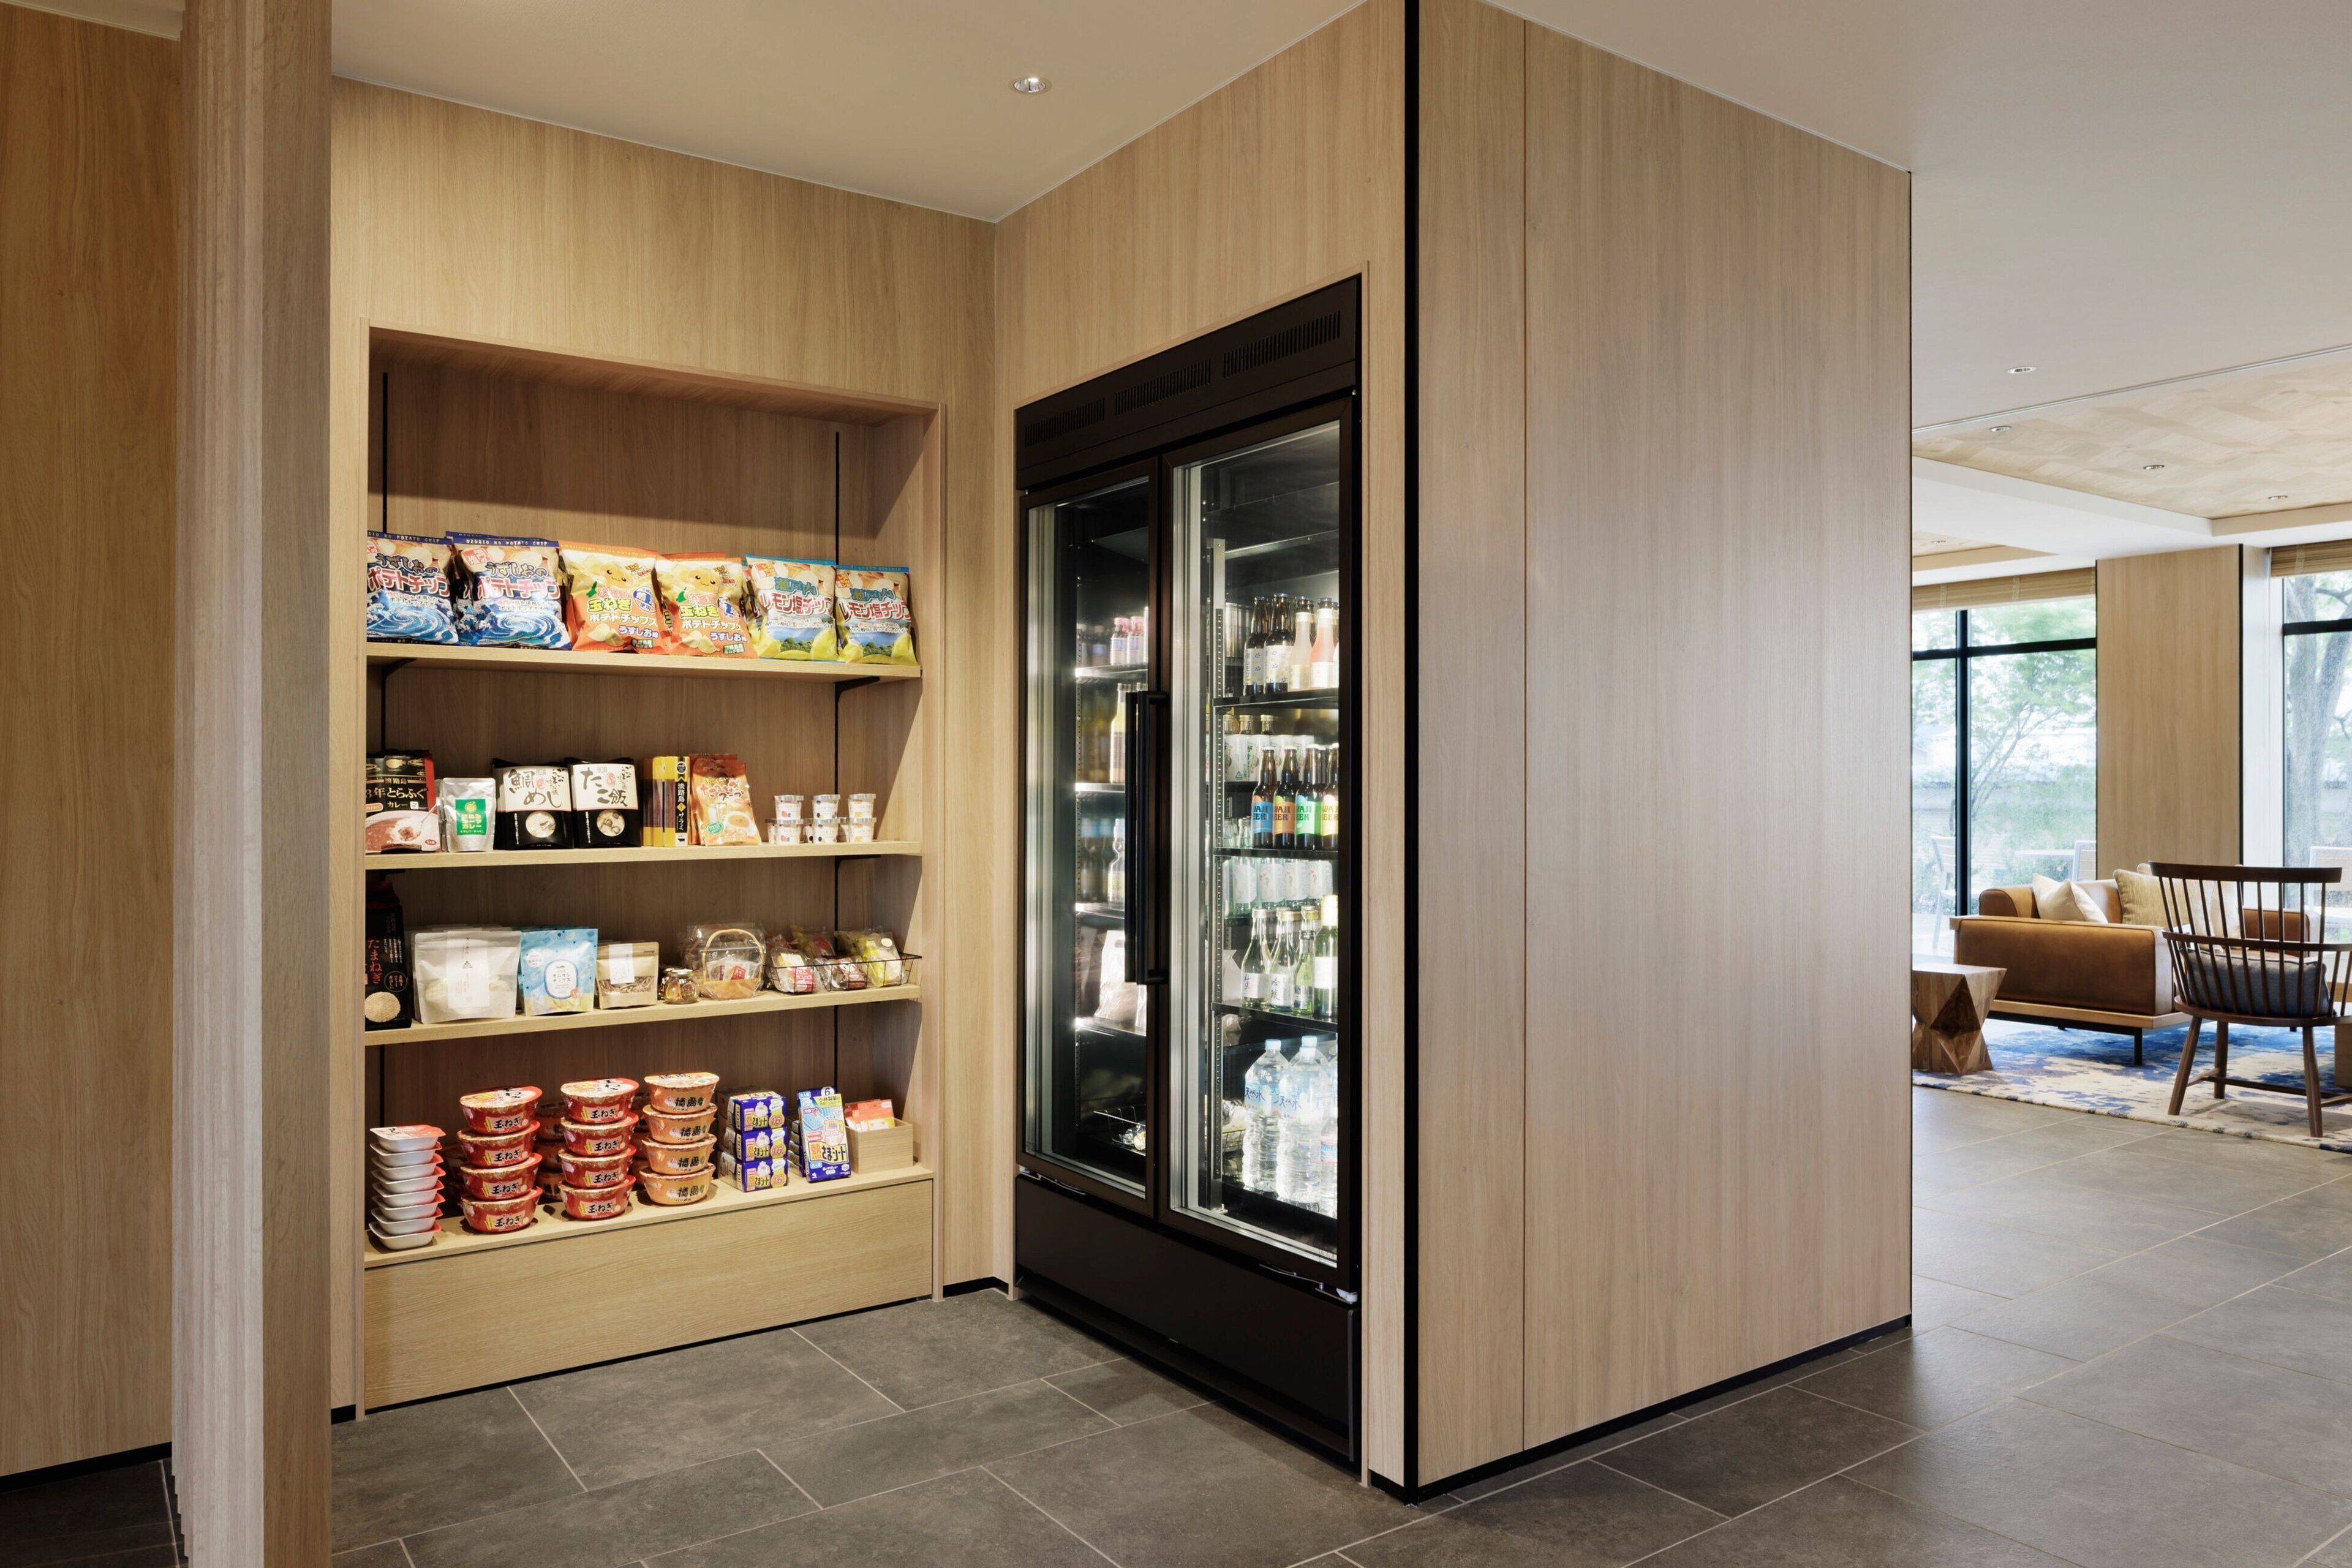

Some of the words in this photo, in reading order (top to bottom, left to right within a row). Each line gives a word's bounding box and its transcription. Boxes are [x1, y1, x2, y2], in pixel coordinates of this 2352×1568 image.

[375, 552, 439, 575] うずしおの
[484, 561, 549, 578] うずしおの
[588, 597, 632, 612] 玉ねぎ
[679, 604, 720, 619] 玉ねぎ
[368, 939, 383, 984] たまねぎ
[824, 1087, 831, 1096] 6
[590, 1107, 617, 1119] 玉ねぎ
[494, 1117, 521, 1129] 玉ねぎ
[594, 1139, 620, 1152] 玉ねぎ
[494, 1149, 521, 1163] 玉ねぎ
[593, 1171, 619, 1184] 玉ねぎ
[491, 1182, 519, 1195] 玉ねぎ
[587, 1202, 614, 1215] 玉ねぎ
[494, 1215, 522, 1228] 玉ねぎ
